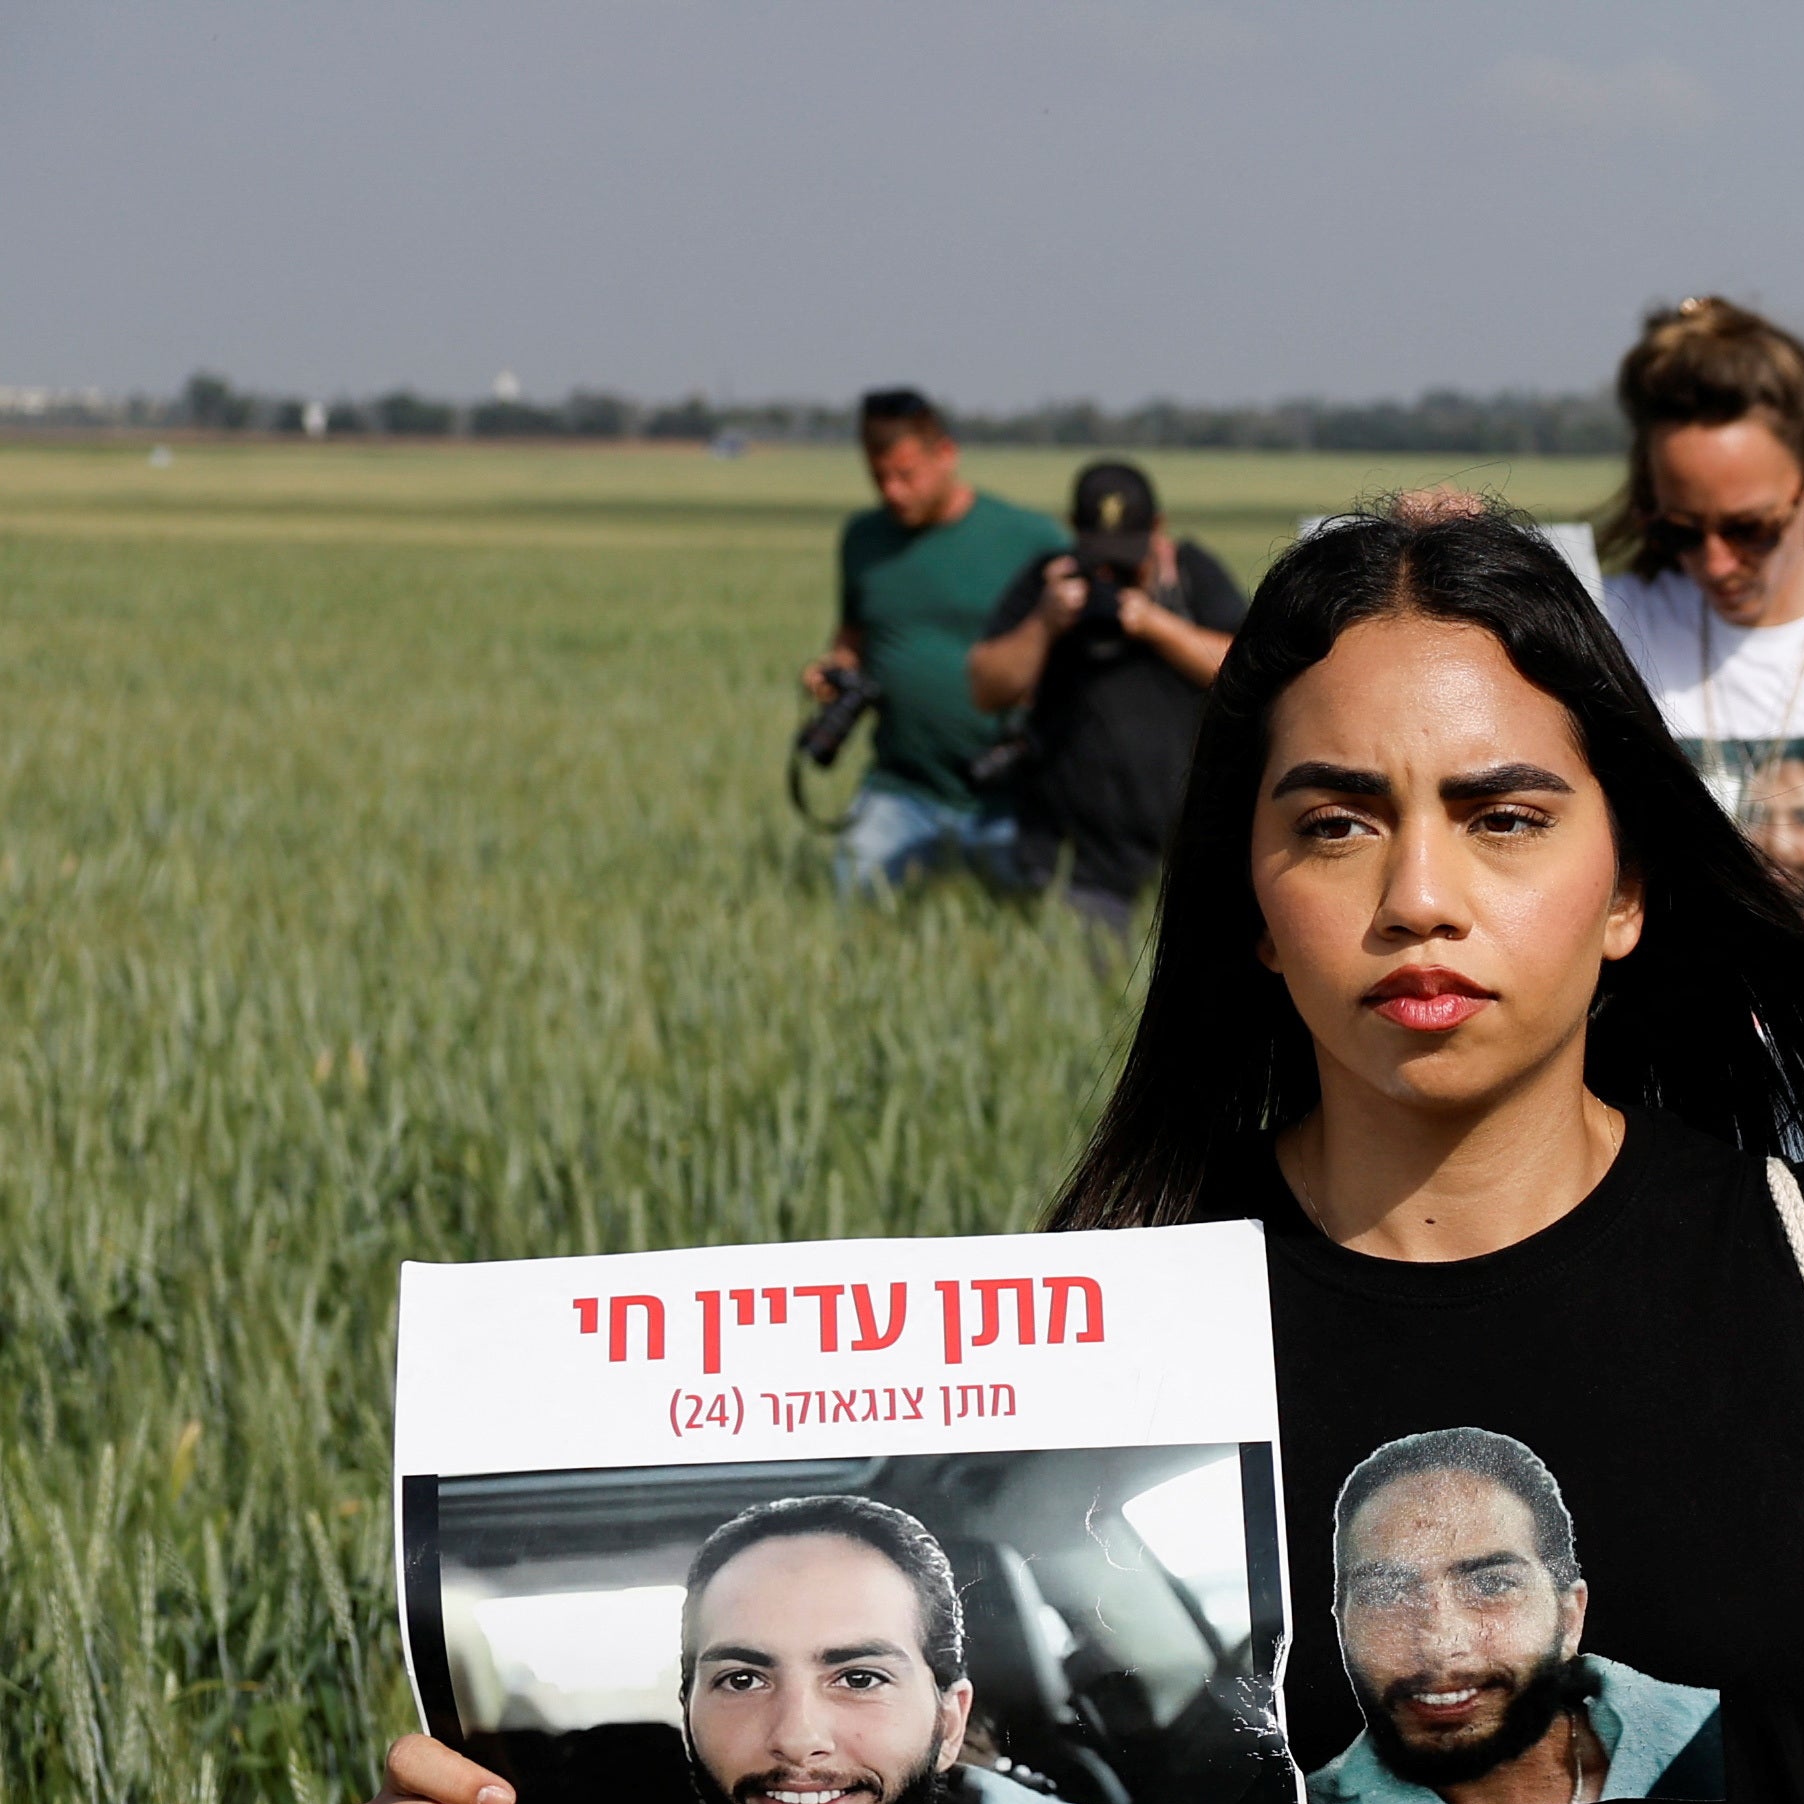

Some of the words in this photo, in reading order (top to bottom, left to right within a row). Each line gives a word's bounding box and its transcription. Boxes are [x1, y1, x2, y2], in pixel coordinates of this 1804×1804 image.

[572, 1289, 666, 1363] חי
[694, 1281, 908, 1375] עדיין
[934, 1275, 1105, 1365] מתן
[669, 1385, 745, 1437] (24)
[761, 1387, 924, 1433] צנגאוקר
[940, 1383, 1017, 1426] מתן
